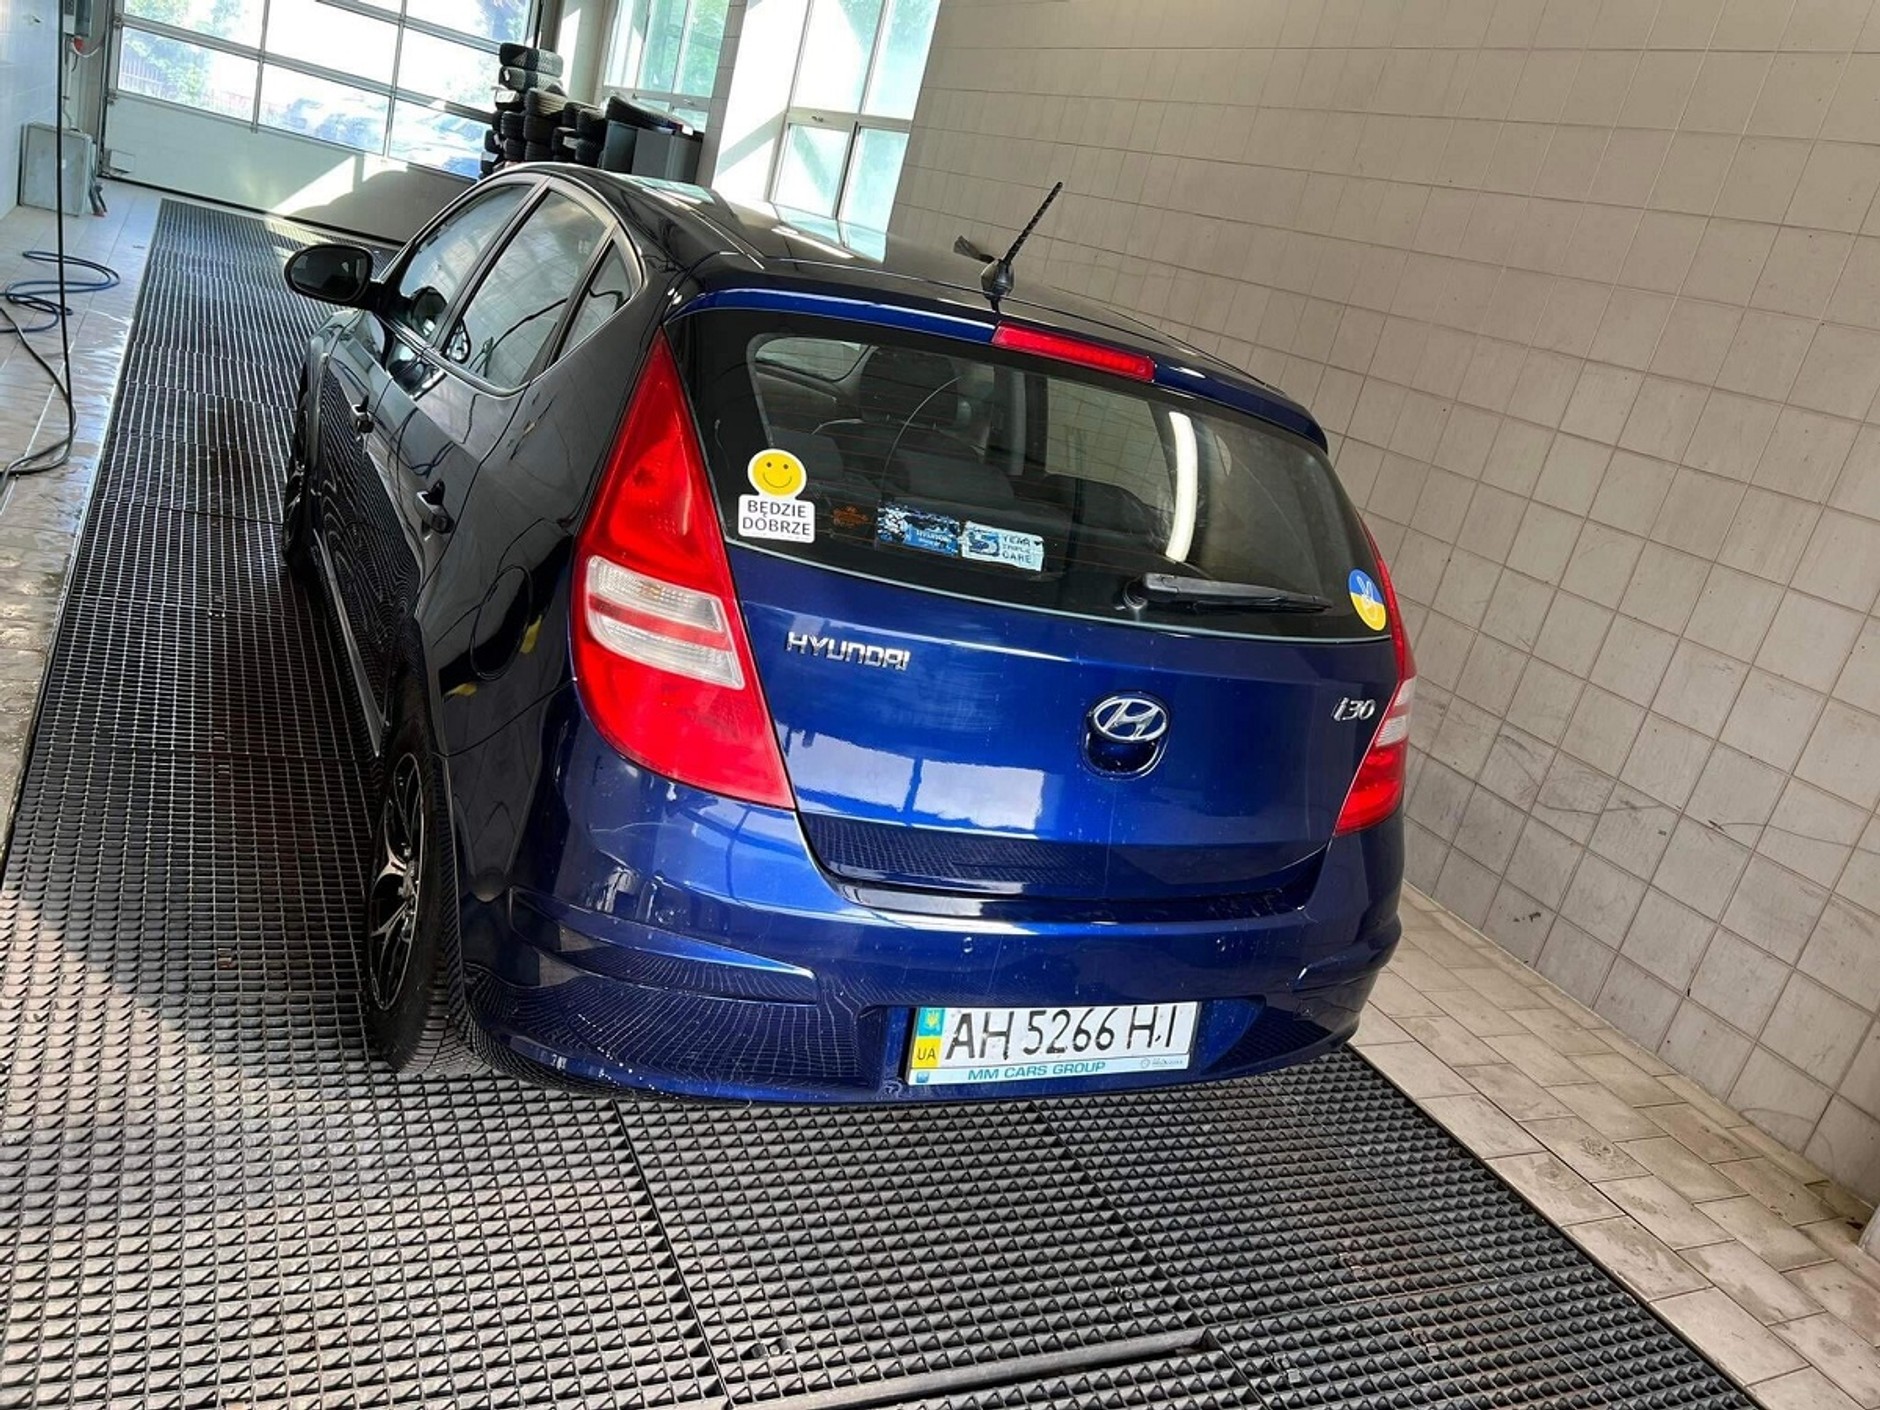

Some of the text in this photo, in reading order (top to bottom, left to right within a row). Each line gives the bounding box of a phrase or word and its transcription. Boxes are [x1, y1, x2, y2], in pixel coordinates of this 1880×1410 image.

[747, 499, 807, 518] BĘDZIE
[742, 516, 812, 536] DOBRZE
[1002, 550, 1032, 563] CARE
[786, 631, 911, 672] HYUNDAI
[1332, 697, 1376, 722] i30
[945, 1010, 1015, 1060] AH
[1022, 1007, 1119, 1056] 5266
[917, 1047, 937, 1061] UA
[968, 1061, 1106, 1081] MM CARS GROUP
